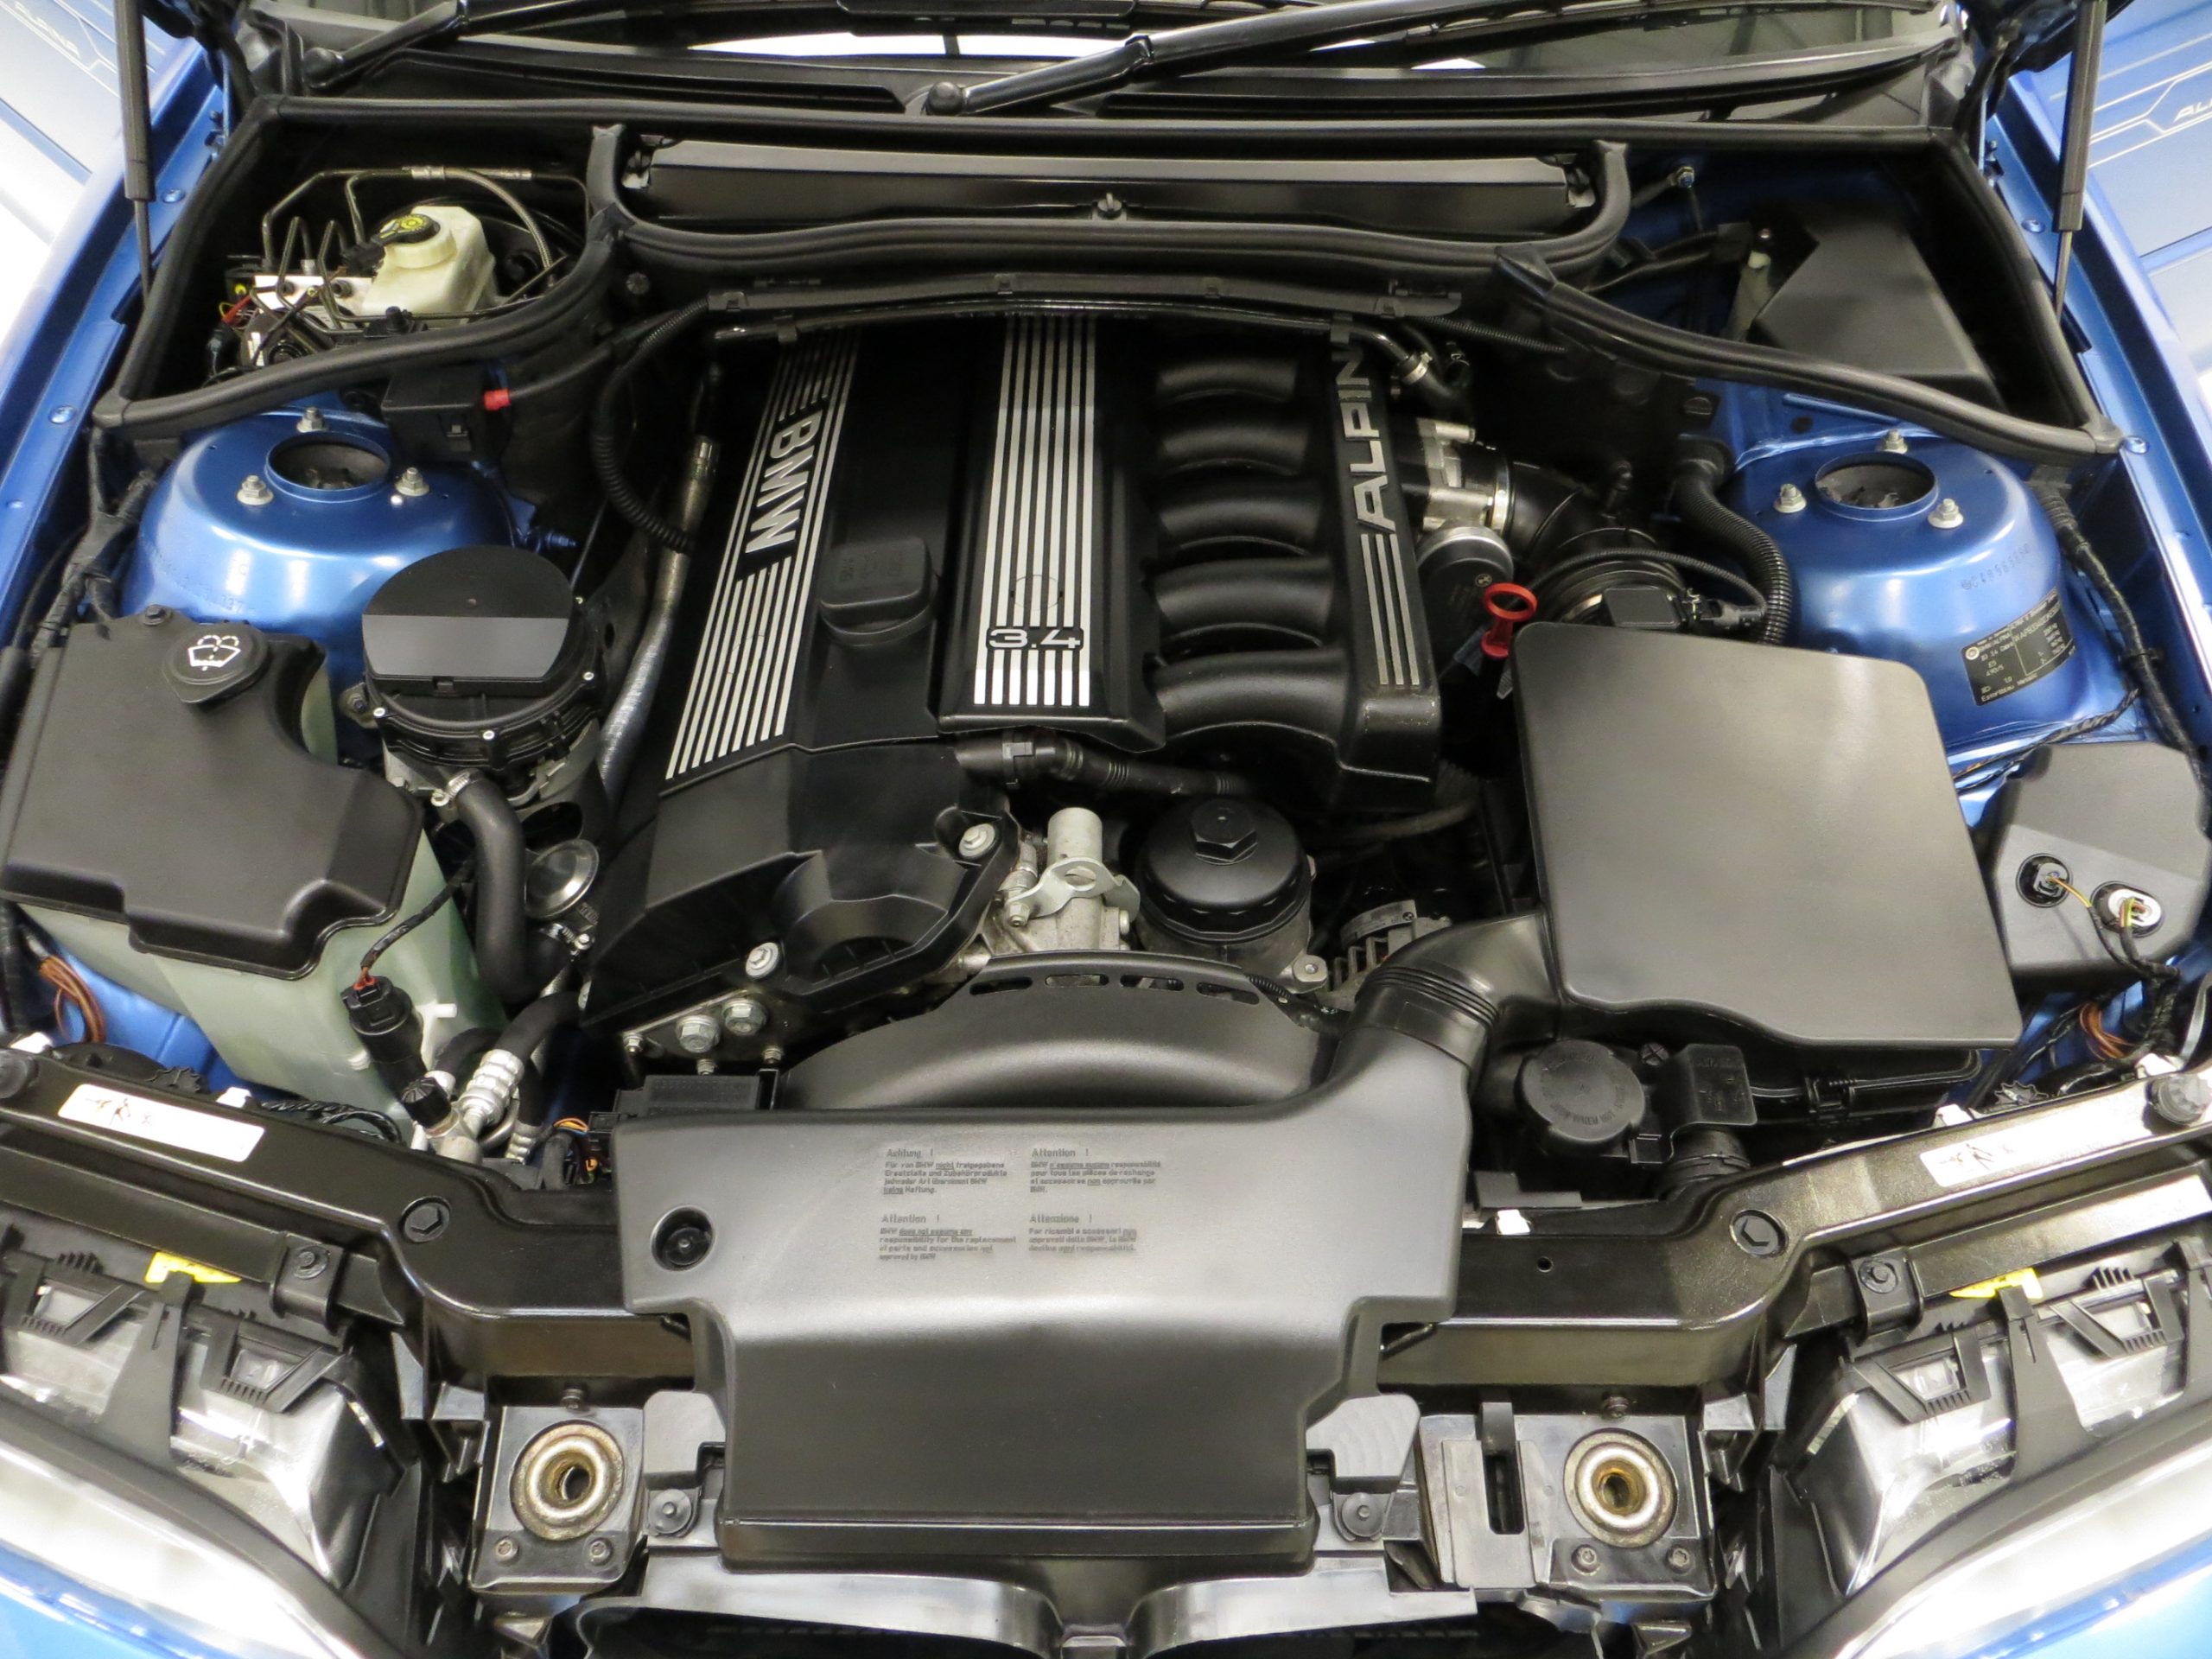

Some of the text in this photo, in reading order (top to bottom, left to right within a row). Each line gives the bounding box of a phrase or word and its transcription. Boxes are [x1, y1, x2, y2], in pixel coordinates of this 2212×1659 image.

[2173, 97, 2212, 124] AL
[1332, 348, 1396, 533] ALPIN
[745, 408, 824, 555] BMW
[988, 627, 1082, 651] 3.4
[1032, 1148, 1076, 1157] Attention
[881, 1213, 926, 1224] Attention
